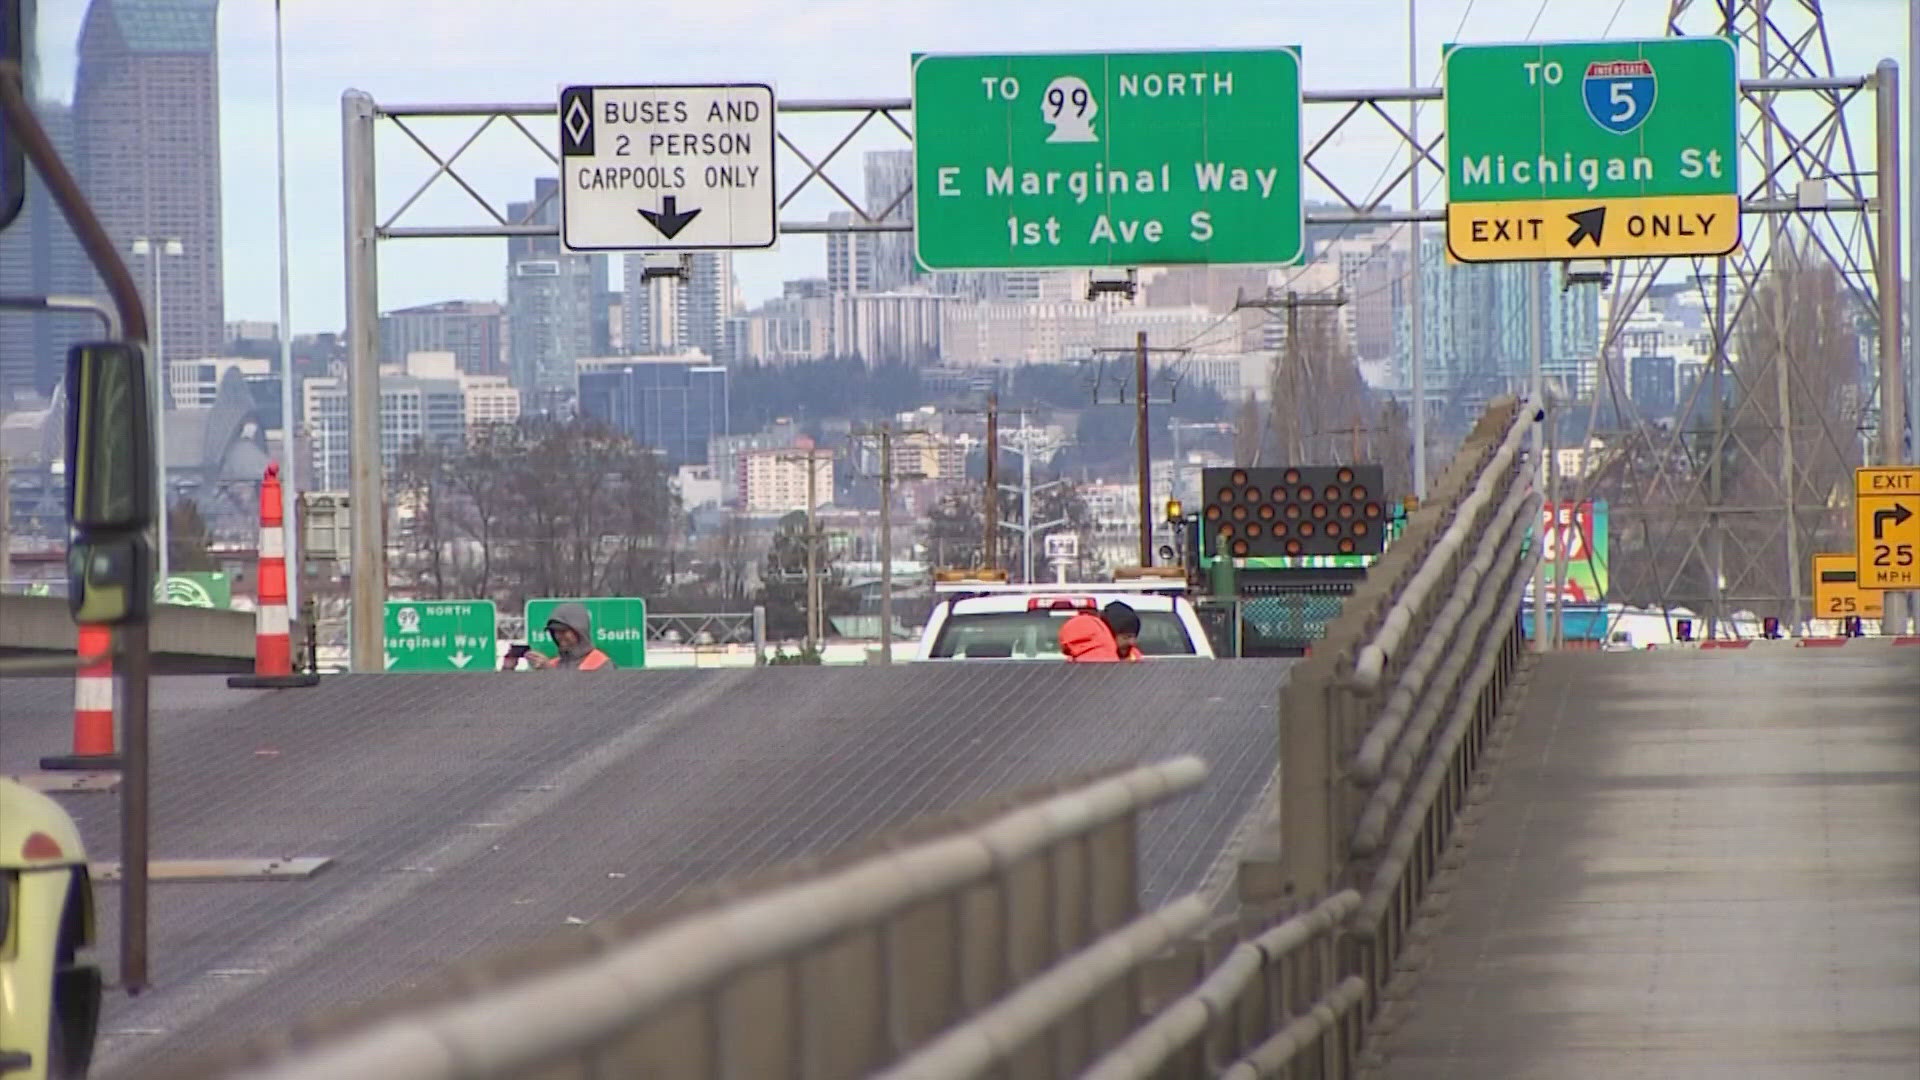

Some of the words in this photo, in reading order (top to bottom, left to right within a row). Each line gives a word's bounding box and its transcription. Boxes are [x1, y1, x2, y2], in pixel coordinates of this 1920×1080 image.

[1524, 62, 1563, 85] TO
[1594, 64, 1644, 76] INTERSTATE
[982, 76, 1019, 100] TO
[1048, 87, 1088, 119] 99
[1118, 72, 1234, 97] NORTH
[1610, 82, 1637, 122] 5
[604, 101, 688, 124] BUSES
[707, 101, 760, 123] AND
[615, 134, 630, 156] 2
[649, 133, 751, 156] PERSON
[578, 167, 686, 190] CARPOOLS
[704, 166, 759, 188] ONLY
[1462, 152, 1653, 191] Michigan
[1680, 148, 1722, 179] St
[938, 167, 961, 196] E
[986, 163, 1170, 204] Marginal
[1195, 162, 1277, 199] Way
[1007, 215, 1061, 246] 1st
[1089, 214, 1164, 245] Ave
[1190, 211, 1213, 242] S
[1471, 218, 1544, 242] EXIT
[1627, 213, 1716, 238] ONLY
[1873, 475, 1913, 489] EXIT
[1874, 544, 1913, 567] 25
[1877, 571, 1912, 583] MPH
[399, 610, 417, 625] 99
[425, 605, 472, 616] NORTH
[1830, 596, 1857, 613] 25
[454, 634, 489, 651] Way
[596, 627, 641, 641] South
